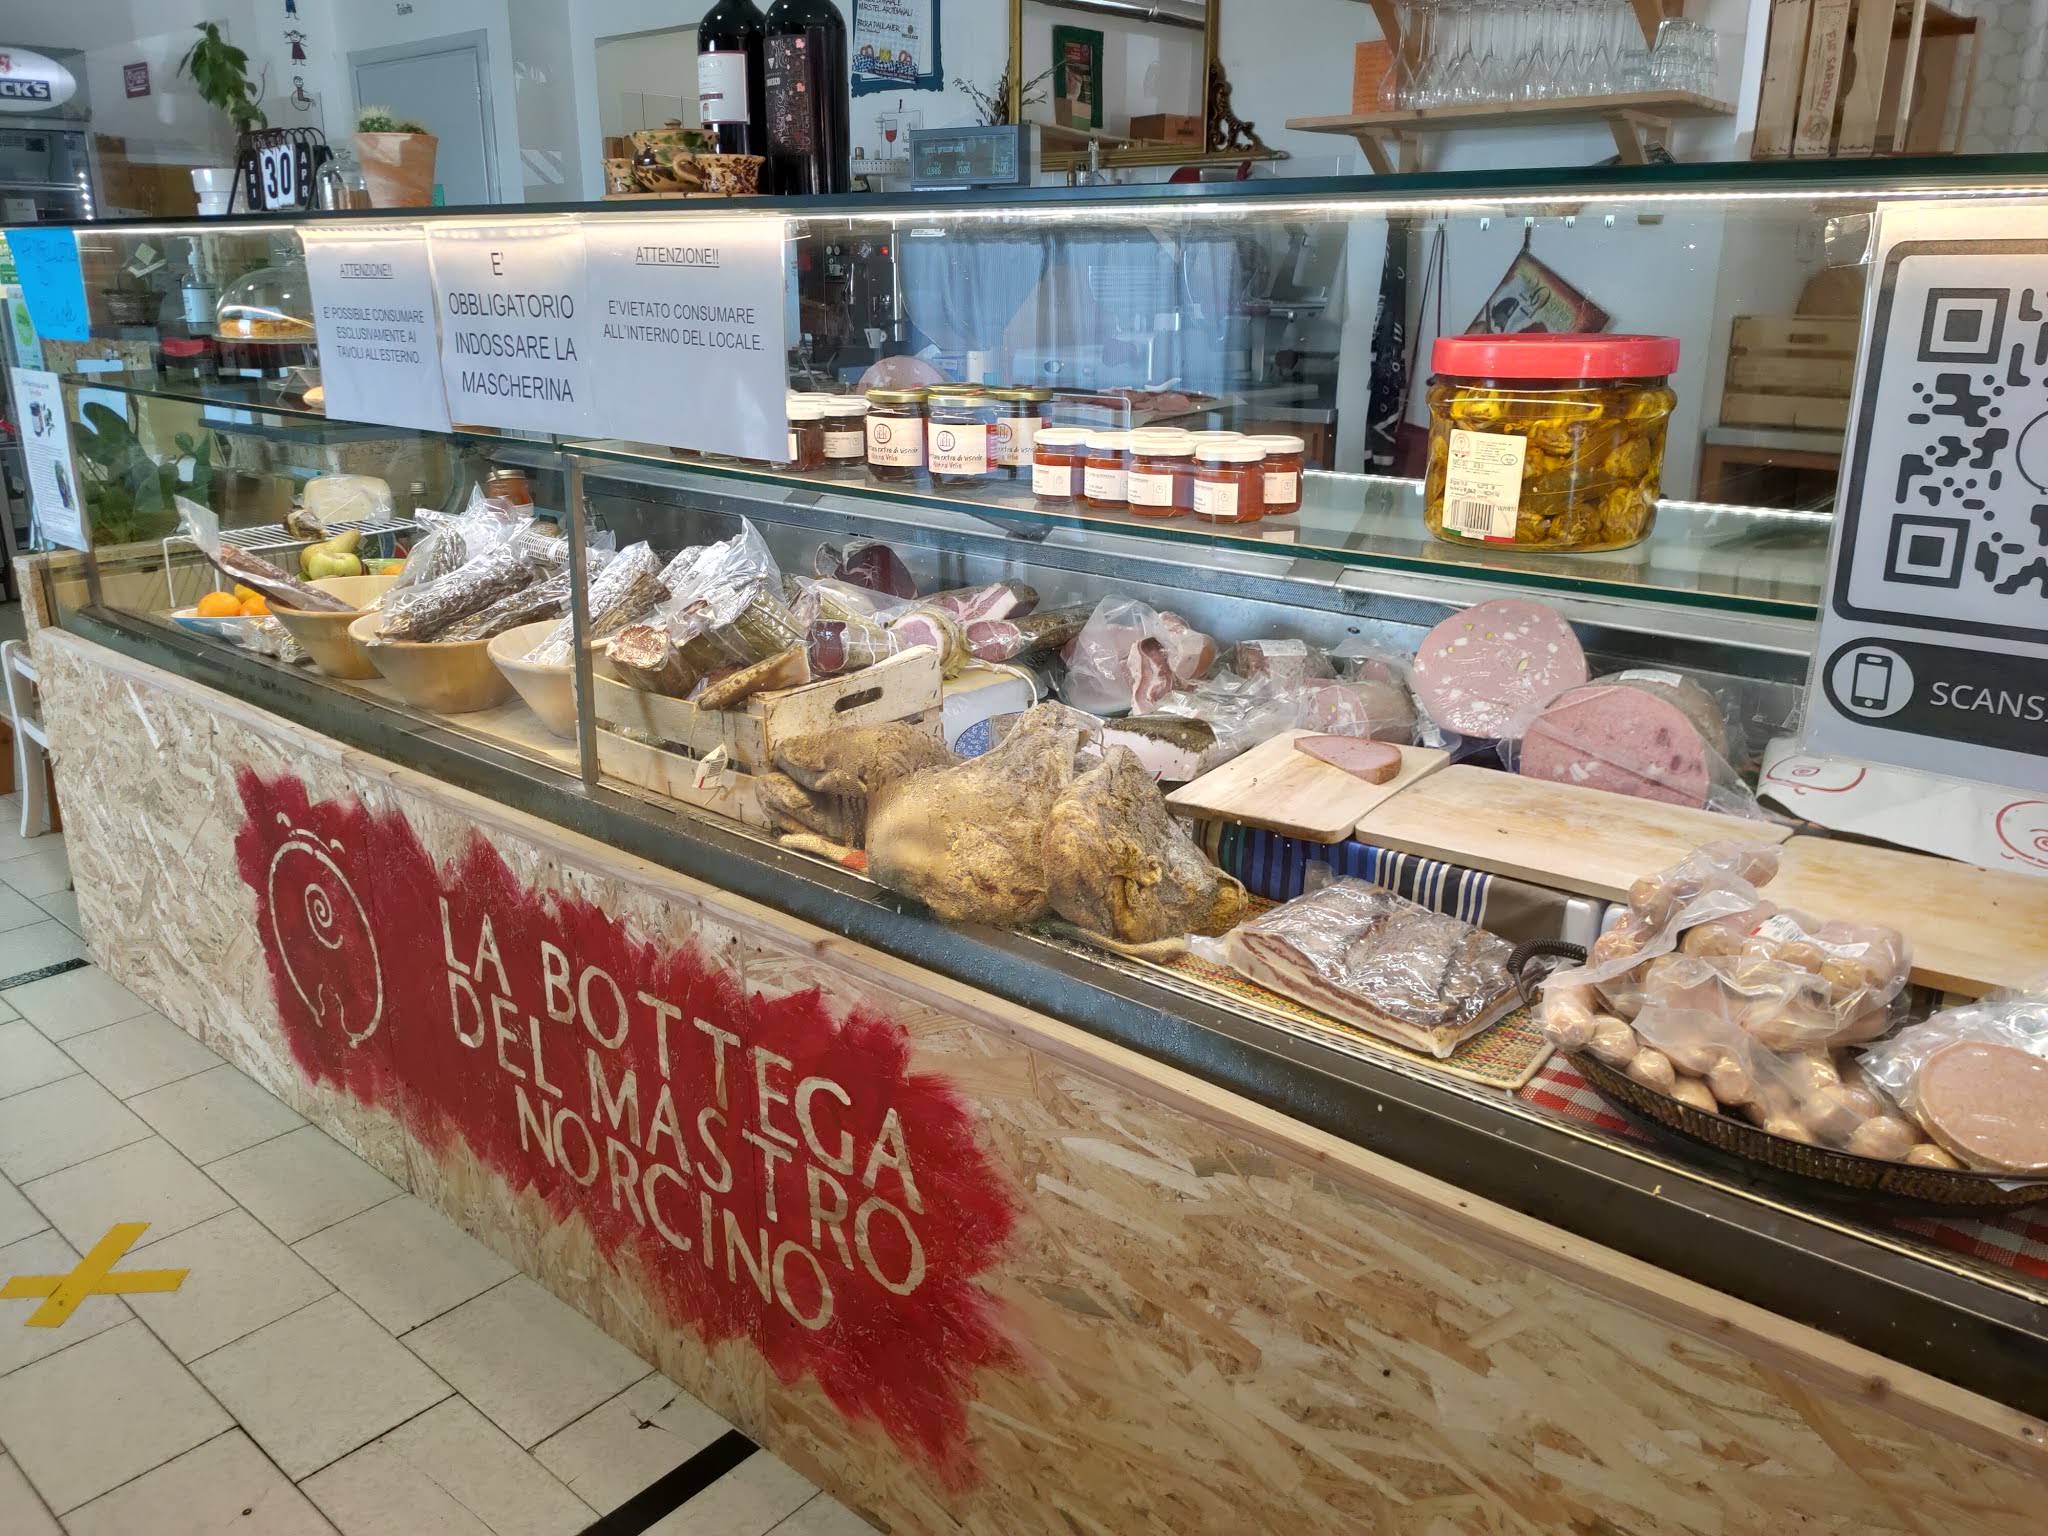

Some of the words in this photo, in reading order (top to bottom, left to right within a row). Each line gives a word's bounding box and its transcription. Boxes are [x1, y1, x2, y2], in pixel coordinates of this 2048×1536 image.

[265, 152, 291, 199] 30
[300, 151, 309, 198] APR
[490, 252, 504, 276] E'
[636, 246, 720, 266] ATTENZIONE!!
[340, 263, 393, 278] ATTENZIONE!!
[332, 307, 372, 321] POSSIBILE
[372, 308, 424, 324] CONSUMARE
[448, 292, 574, 319] OBBLIGATORIO
[673, 304, 755, 324] CONSUMARE
[336, 326, 406, 343] ESCLUSIVAMENTE
[408, 329, 417, 343] AI
[455, 332, 551, 360] INDOSSARE
[555, 337, 578, 361] LA
[603, 323, 680, 344] ALL'INTERNO
[683, 329, 706, 347] DEL
[709, 331, 765, 351] LOCALE.
[336, 345, 365, 359] TAVOLI
[461, 370, 575, 402] MASCHERINA
[1930, 681, 2048, 723] SCANS
[439, 896, 512, 997] LA
[541, 940, 925, 1215] BOTTEGA
[448, 970, 563, 1099] DEL
[587, 1048, 926, 1296] MASTRO
[515, 1085, 834, 1331] NORCINO
